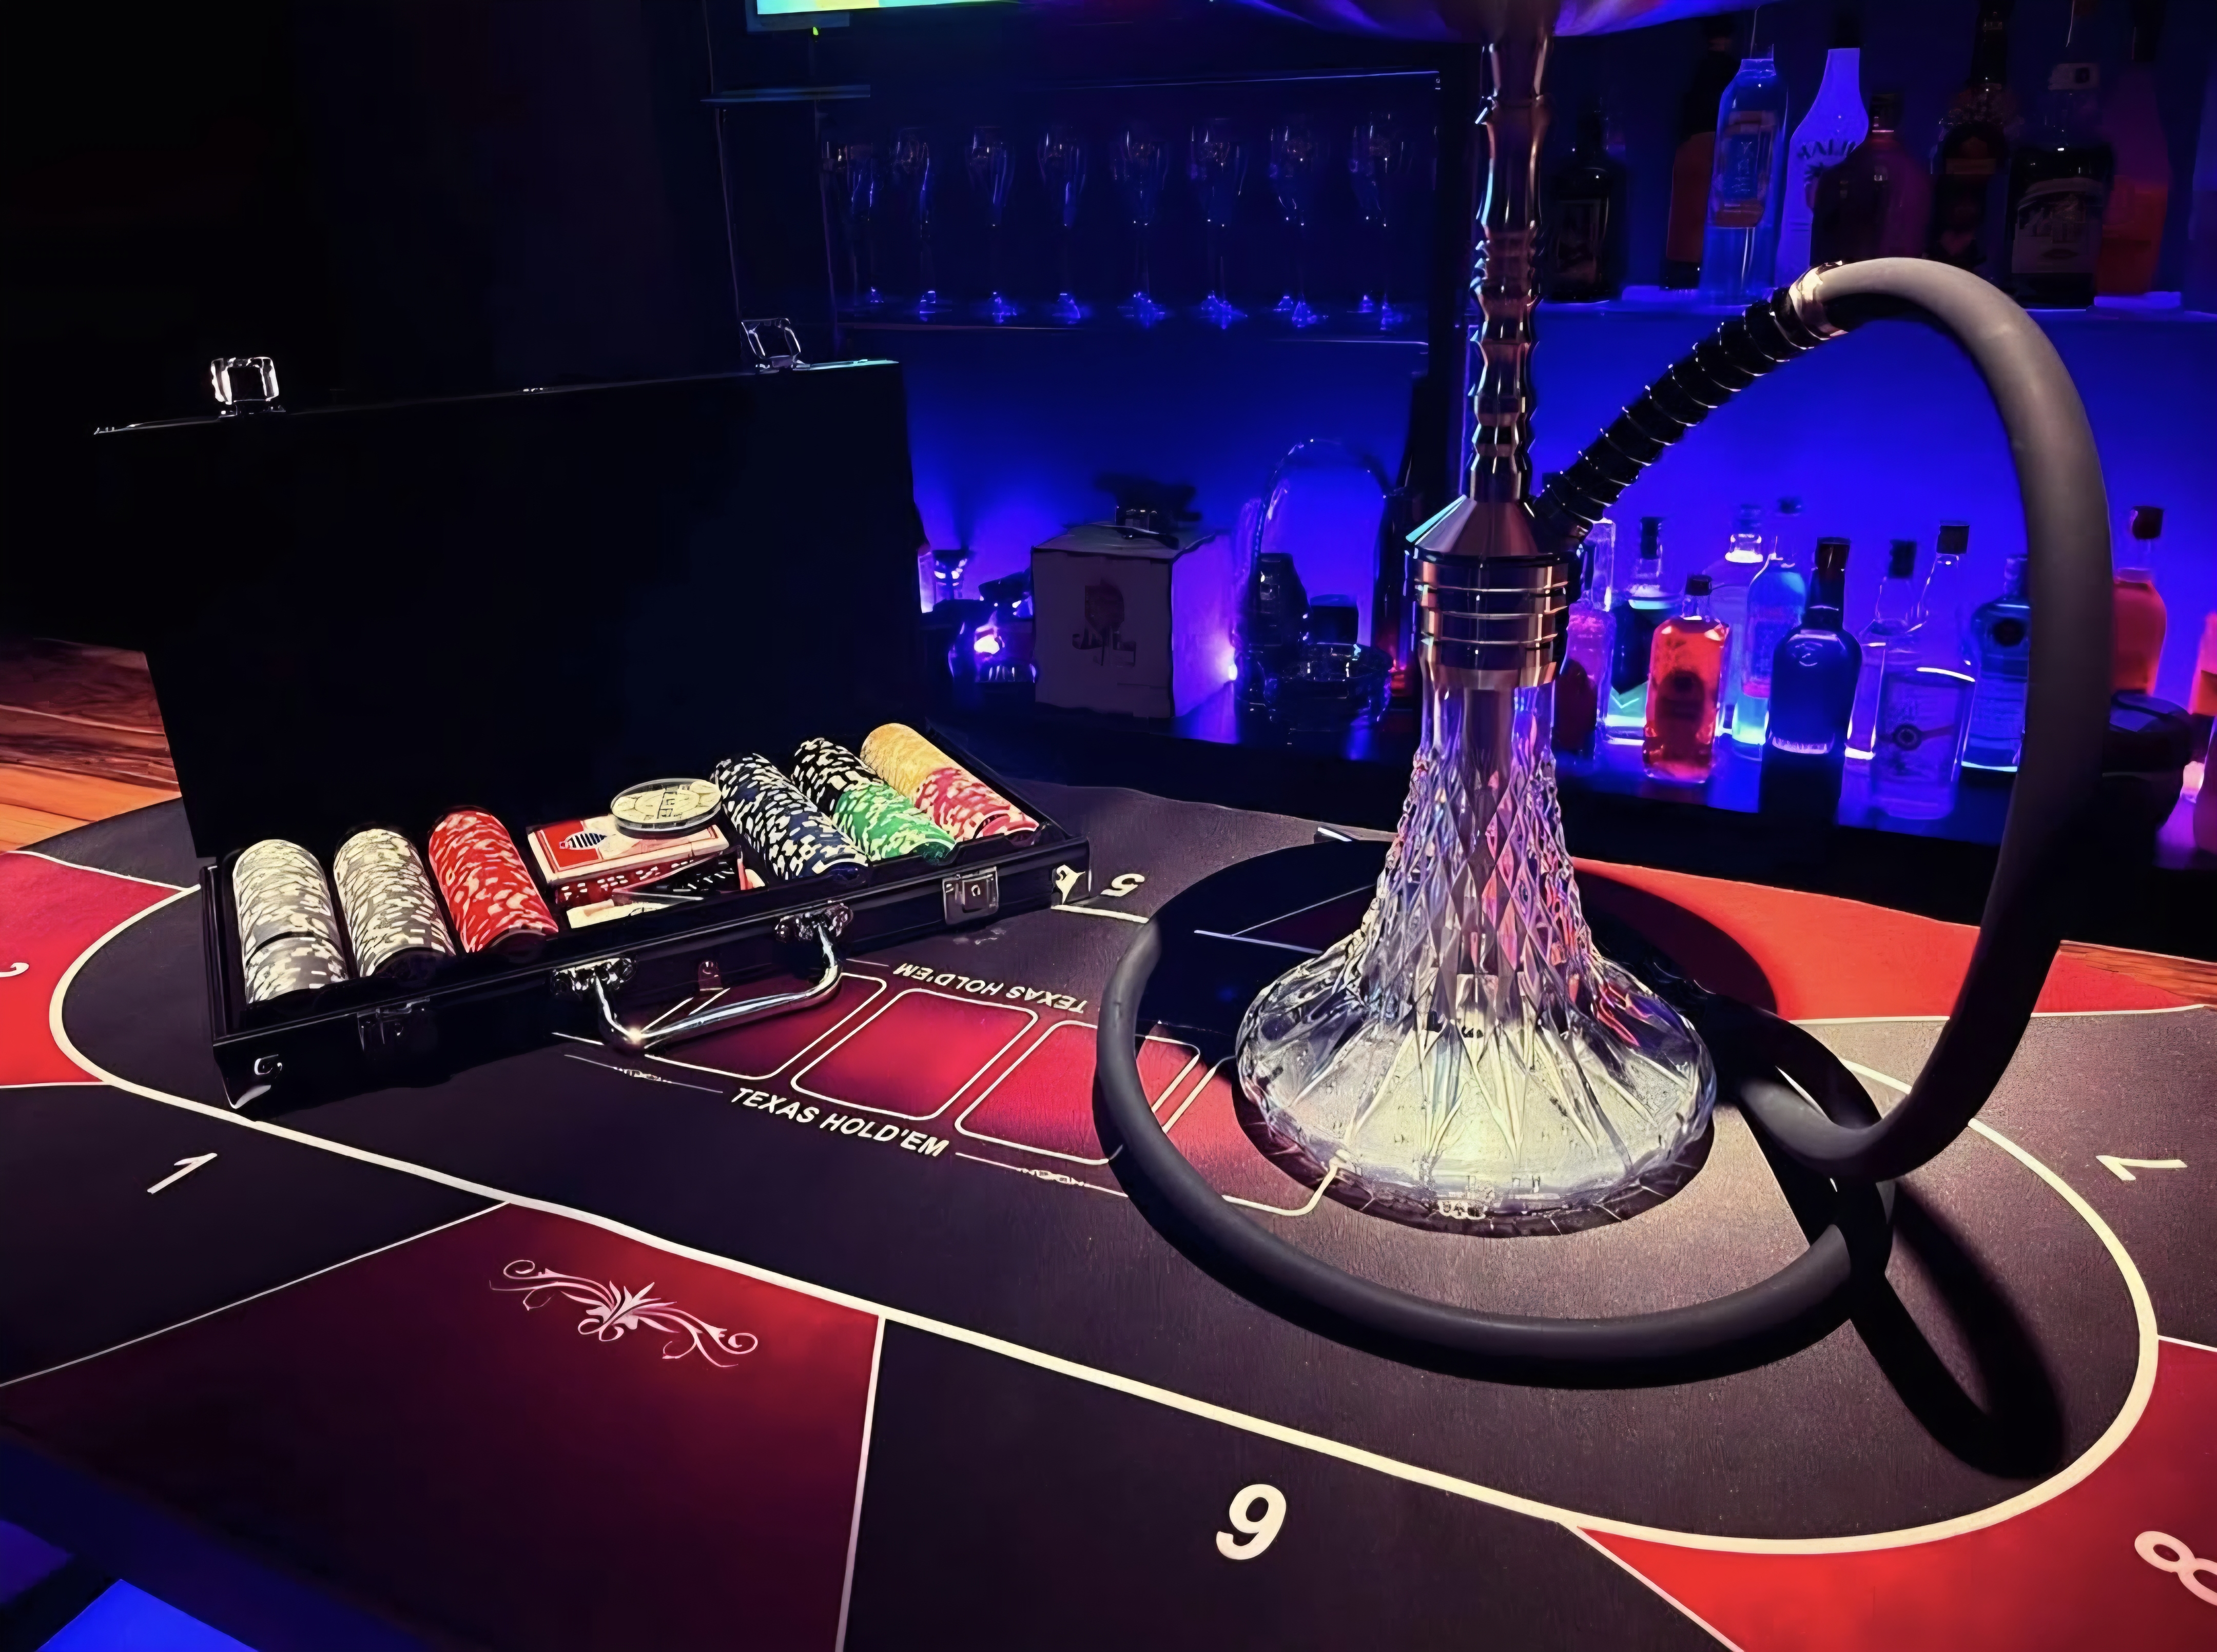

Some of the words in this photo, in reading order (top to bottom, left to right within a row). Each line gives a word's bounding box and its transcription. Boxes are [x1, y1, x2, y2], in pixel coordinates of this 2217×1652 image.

[893, 962, 1004, 996] HOLD'EM
[1006, 986, 1087, 1014] TEXAS
[731, 1087, 820, 1123] TEXAS
[820, 1113, 949, 1157] HOLD'EM
[147, 1152, 218, 1194] 1
[1216, 1484, 1287, 1560] 9
[2134, 1530, 2217, 1606] 8
